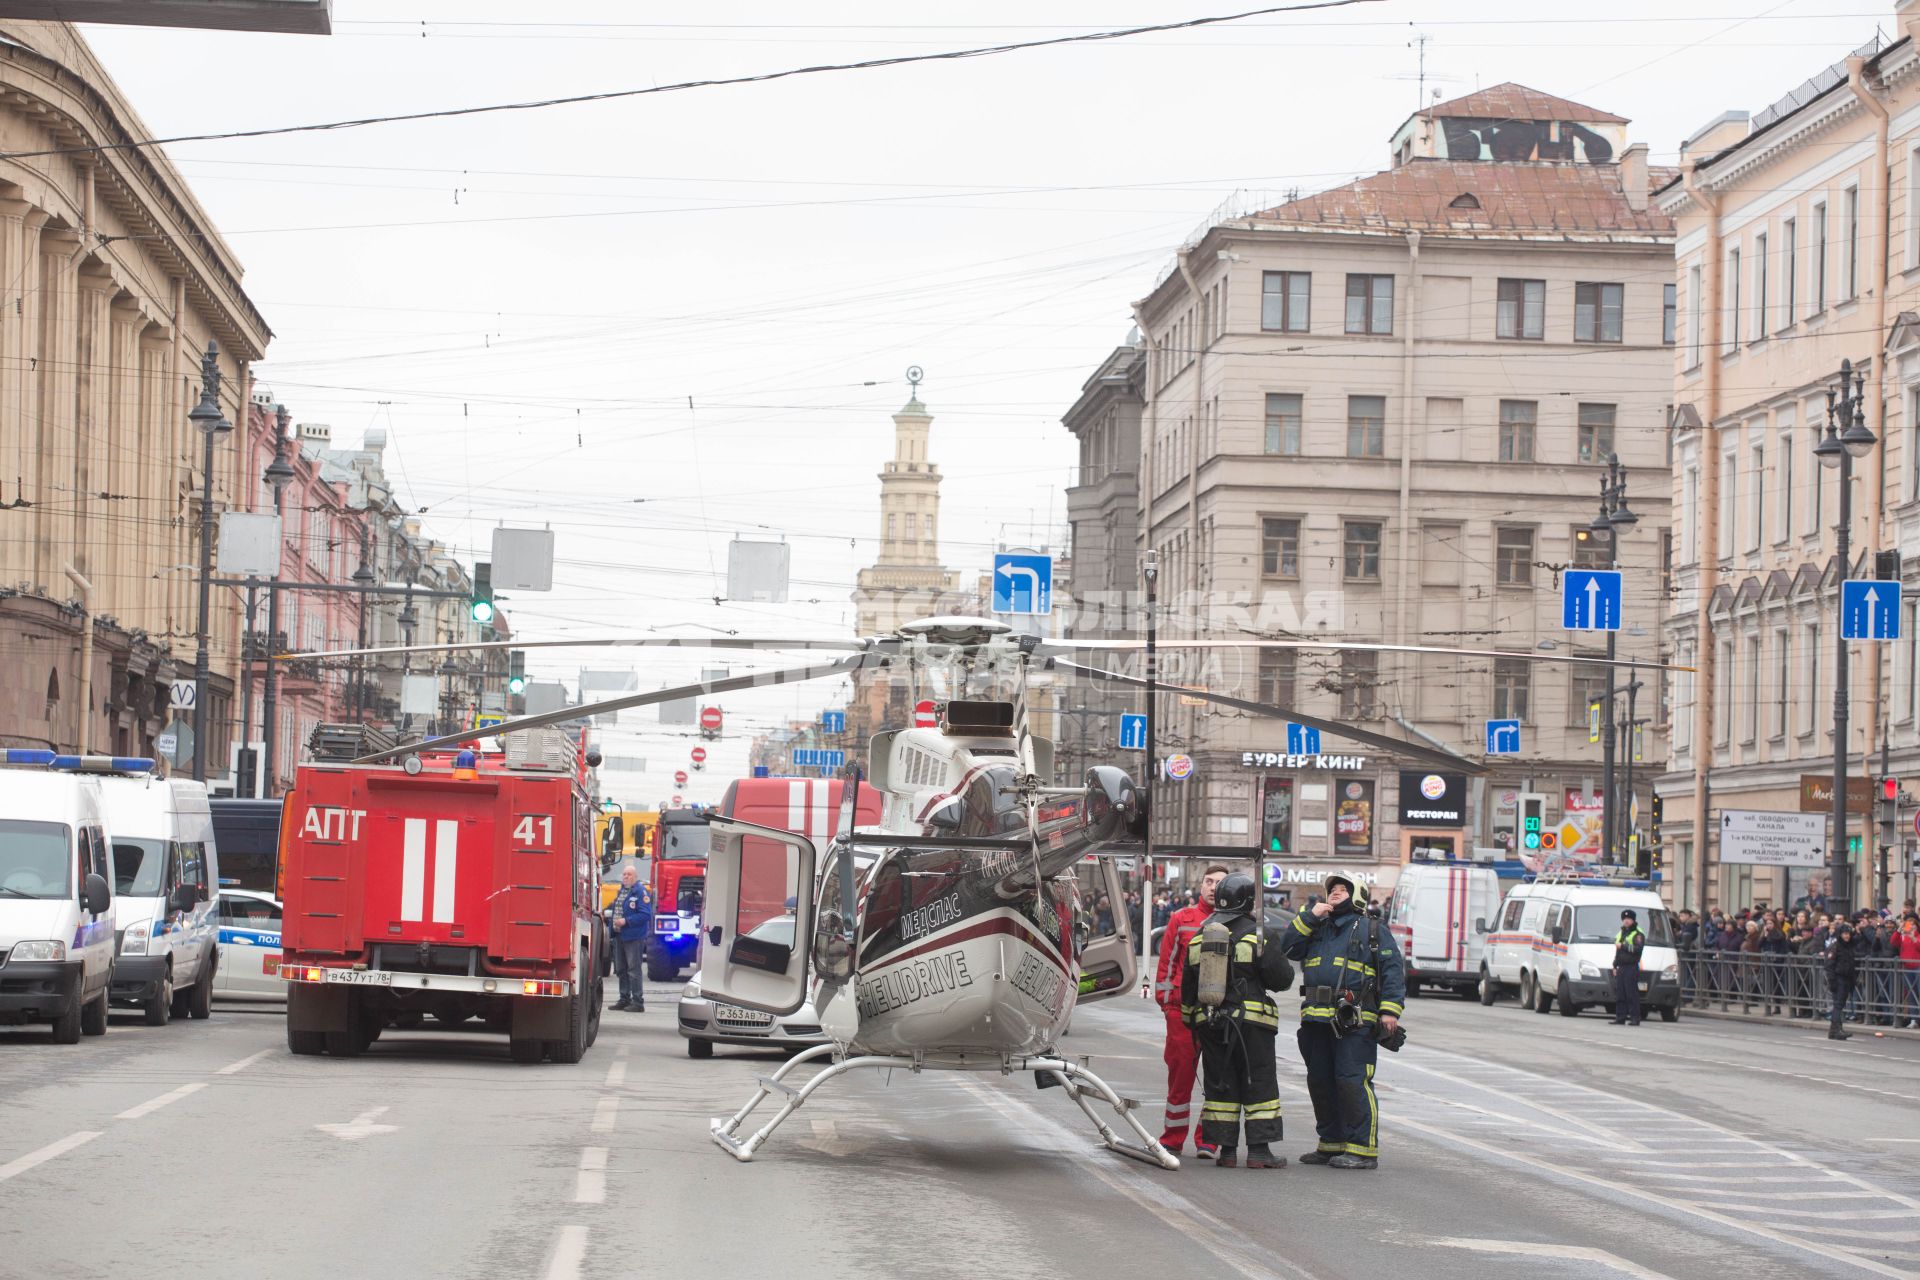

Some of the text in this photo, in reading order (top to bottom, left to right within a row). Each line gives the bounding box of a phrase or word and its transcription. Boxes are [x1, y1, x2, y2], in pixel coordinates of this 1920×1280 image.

[1242, 752, 1366, 770] БУРГЕР КИНГ
[1407, 810, 1458, 820] РЕСТОРАН
[1759, 815, 1799, 823] ОБВОДНОГО
[298, 807, 367, 840] АПТ
[513, 816, 552, 846] 41
[1525, 817, 1540, 831] 60
[1741, 834, 1811, 844] КРАСНОАРМЕЙСКАЯ
[1742, 848, 1798, 857] ИЗМАЙЛОВСКИЙ
[901, 893, 961, 940] МЕДСПАС
[860, 950, 973, 1018] HELIDRIVE
